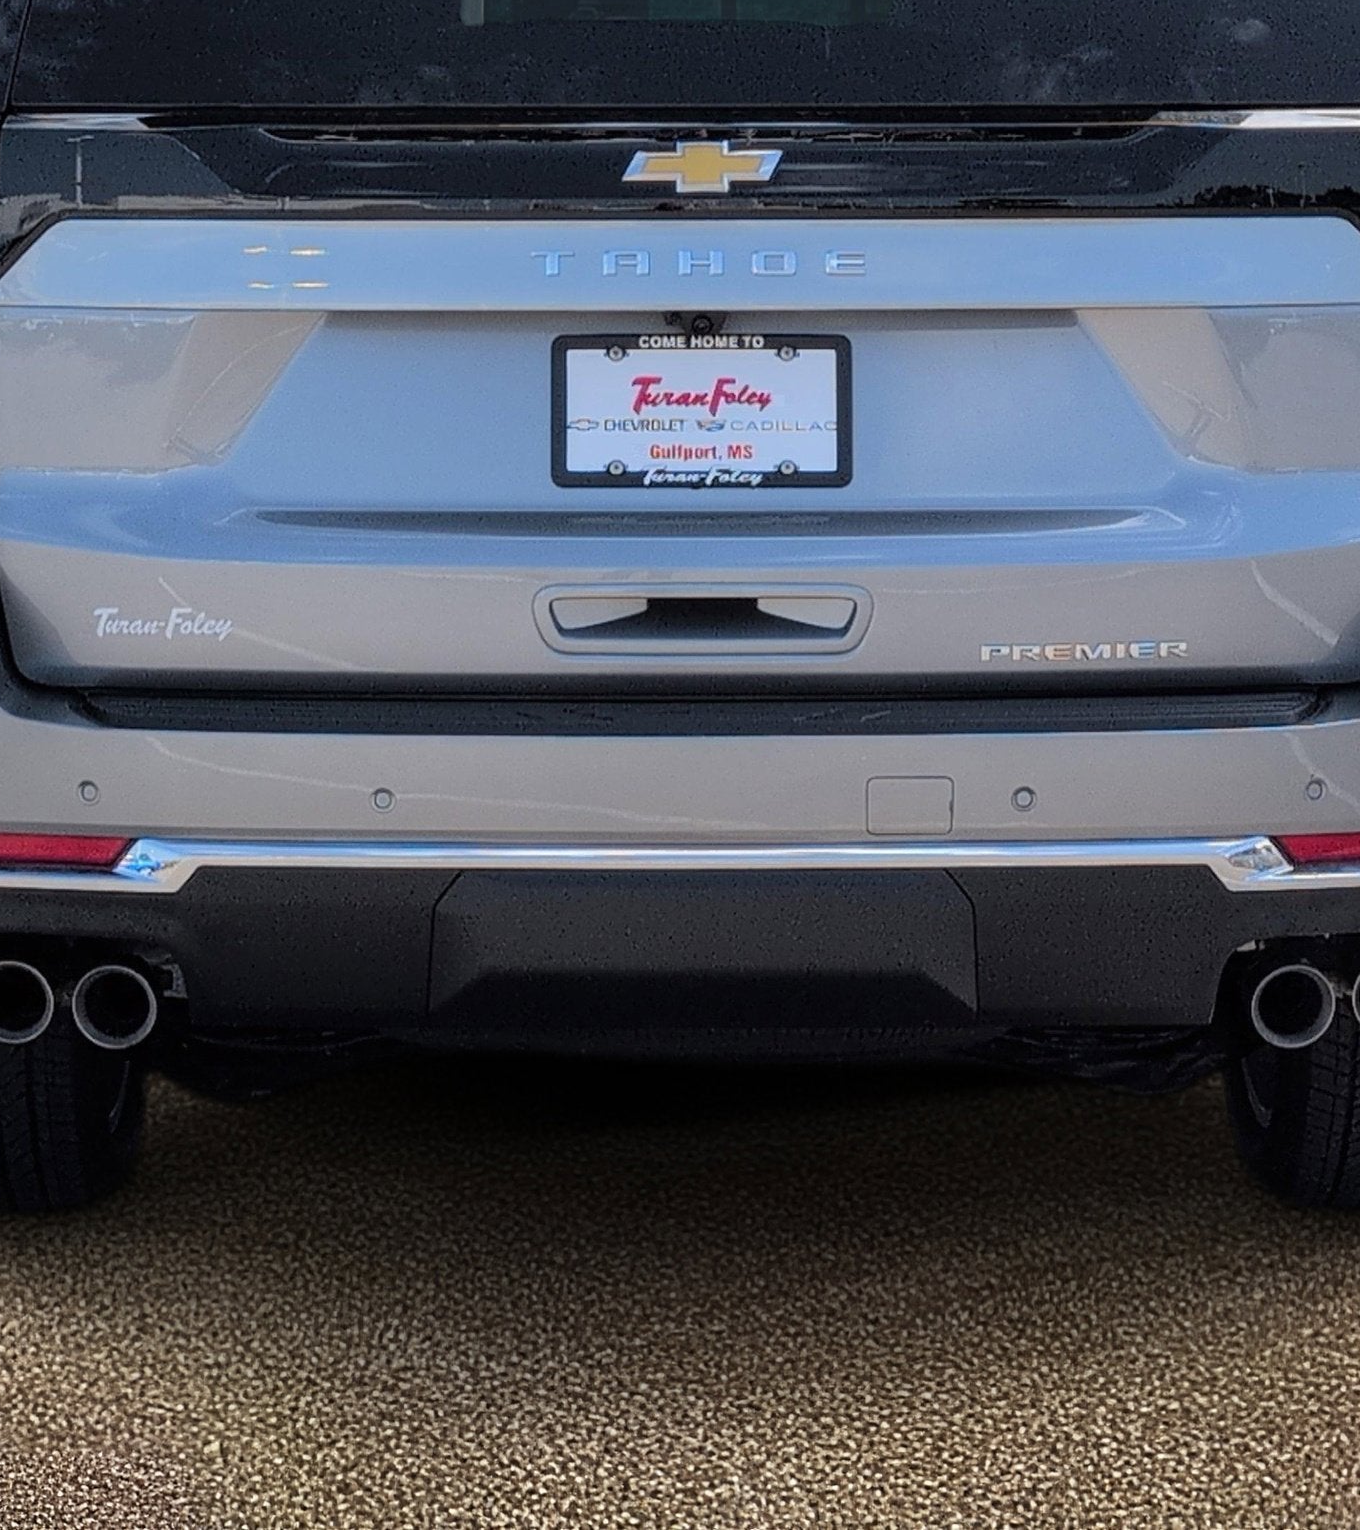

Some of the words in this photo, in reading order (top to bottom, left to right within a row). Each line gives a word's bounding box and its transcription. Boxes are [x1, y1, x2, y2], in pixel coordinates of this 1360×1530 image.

[531, 250, 866, 277] TAHOE
[639, 335, 686, 349] COME
[690, 335, 738, 349] HOME
[742, 335, 765, 349] TO
[604, 419, 684, 432] CHEVROLET
[730, 420, 837, 431] CADILLAC
[650, 444, 723, 461] Gulfport,
[727, 445, 752, 460] MS
[980, 641, 1189, 662] PREMIER
